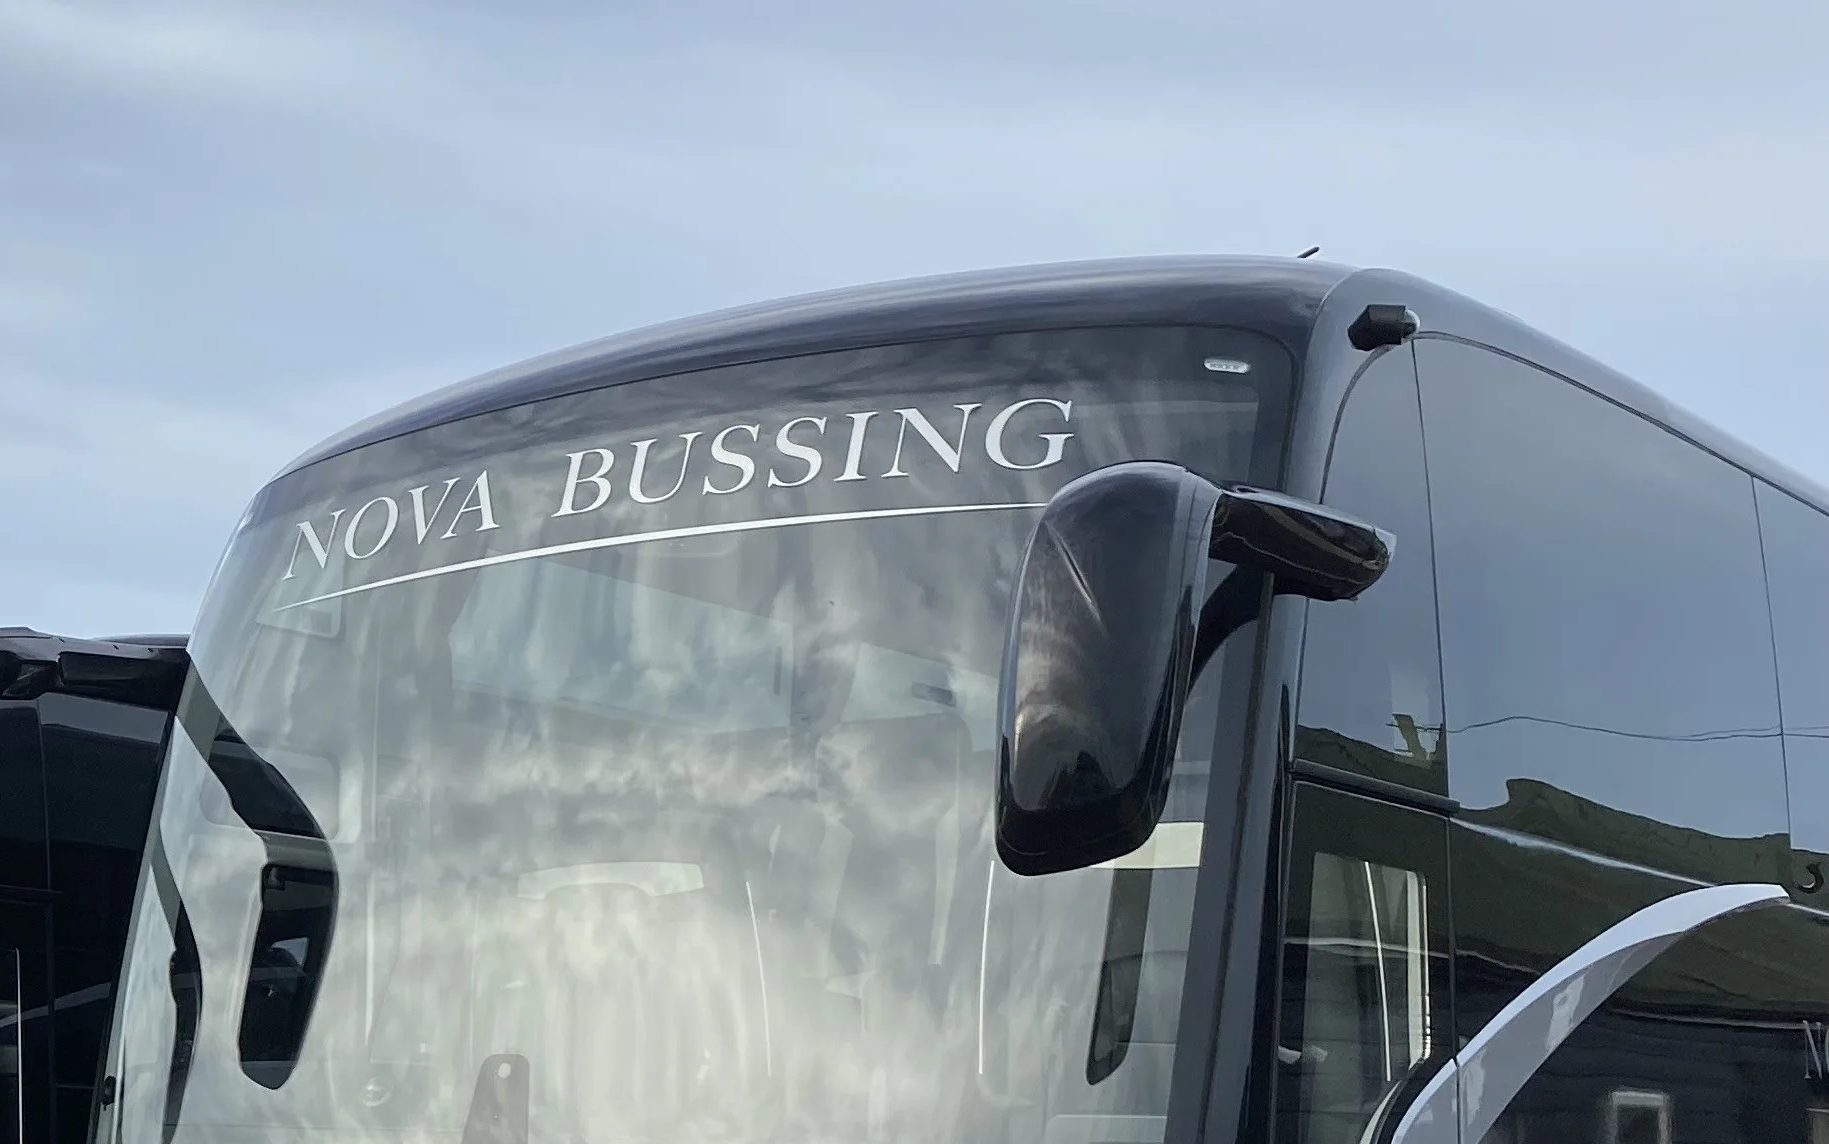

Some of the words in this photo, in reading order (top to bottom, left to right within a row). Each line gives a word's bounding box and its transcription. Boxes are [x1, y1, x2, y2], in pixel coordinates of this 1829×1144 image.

[282, 470, 500, 581] NOVA
[551, 398, 1075, 518] BUSSING
[1803, 1020, 1829, 1080] N
